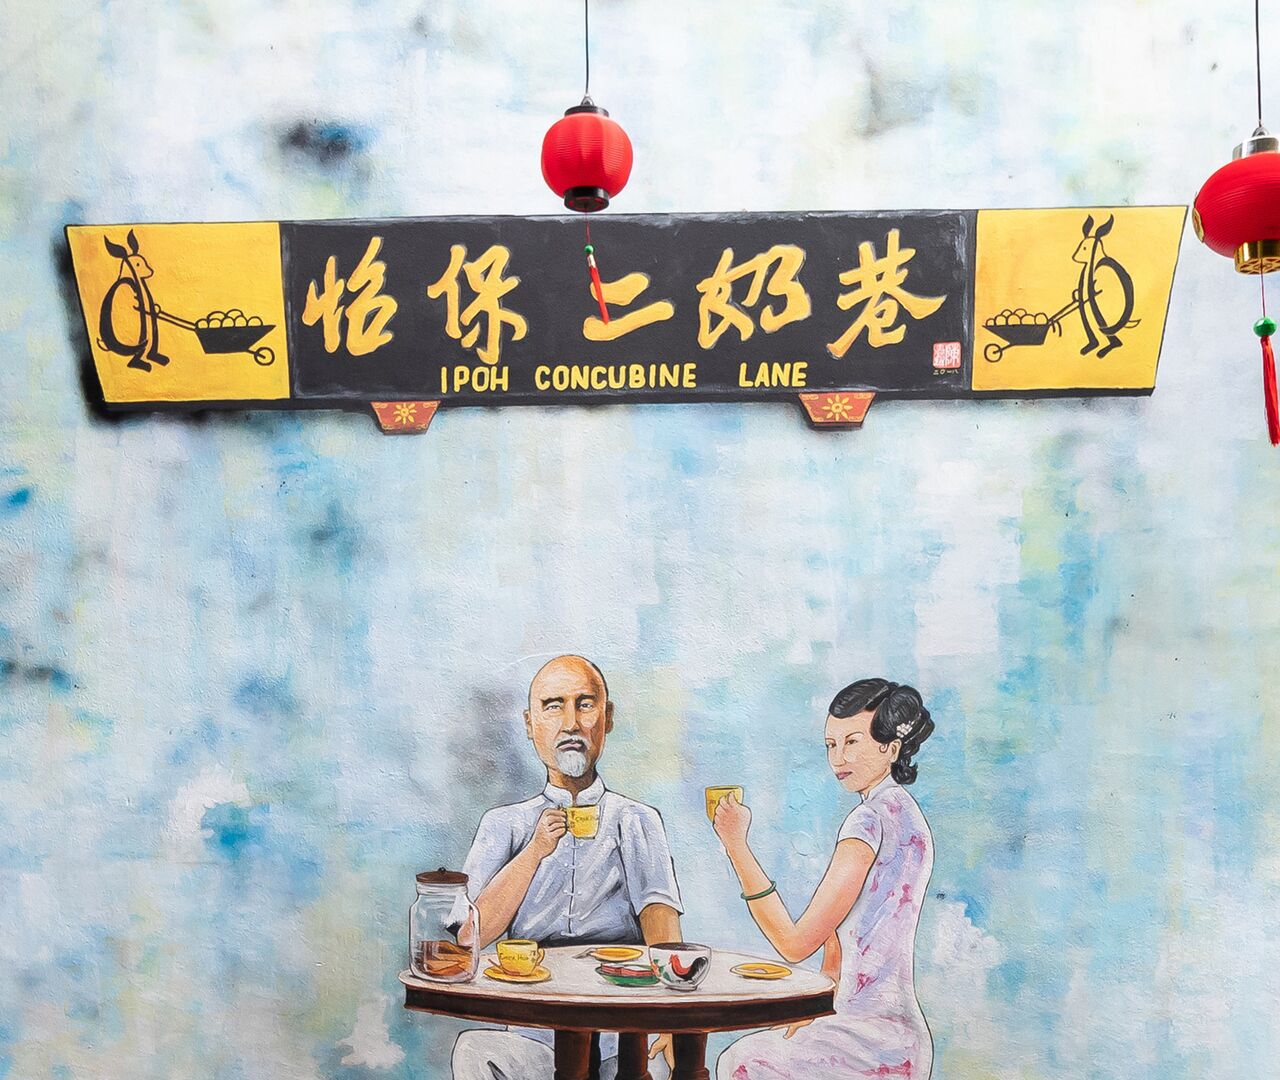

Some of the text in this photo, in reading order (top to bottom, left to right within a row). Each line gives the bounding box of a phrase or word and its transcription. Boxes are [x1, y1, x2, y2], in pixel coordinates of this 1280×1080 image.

[302, 229, 947, 364] 怡保二奶巷
[440, 361, 809, 394] IPOH CONCUBINE LANE
